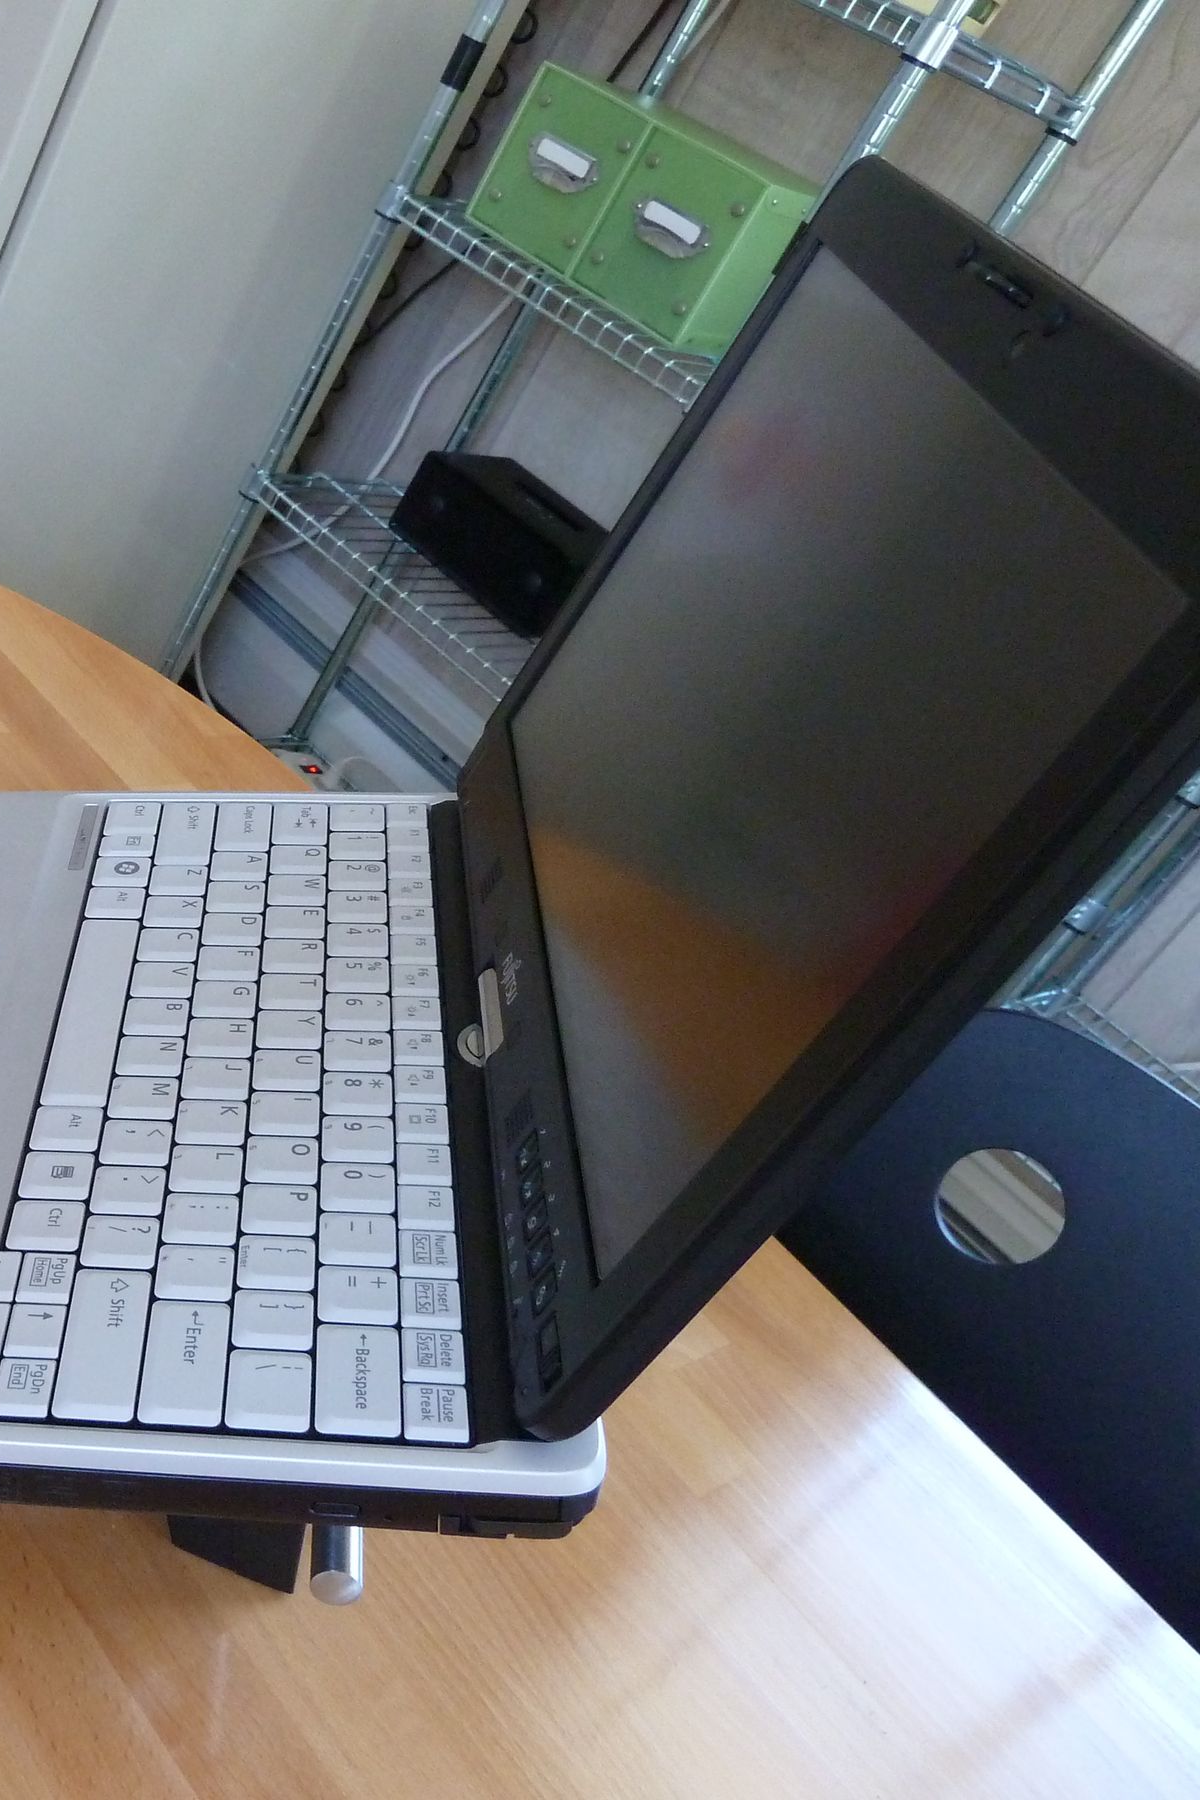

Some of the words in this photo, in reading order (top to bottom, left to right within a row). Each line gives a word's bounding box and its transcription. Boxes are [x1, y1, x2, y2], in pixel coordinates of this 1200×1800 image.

[301, 807, 311, 818] Tab
[188, 815, 199, 829] Shift
[244, 820, 254, 834] Lock
[305, 848, 320, 857] Q
[246, 855, 262, 864] A
[411, 855, 421, 863] F2
[364, 864, 381, 873] @
[304, 878, 320, 889] W
[182, 900, 198, 908] X
[241, 917, 257, 925] D
[177, 932, 193, 940] C
[346, 927, 362, 935] 4
[416, 937, 427, 946] F5
[367, 961, 383, 971] %
[172, 967, 189, 976] V
[418, 968, 429, 977] F6
[299, 979, 317, 987] T
[501, 952, 521, 1005] FUJITSU
[233, 986, 250, 996] G
[166, 1003, 183, 1011] B
[345, 998, 363, 1006] 6
[419, 1000, 430, 1009] F7
[297, 1016, 316, 1026] Y
[229, 1023, 247, 1033] H
[346, 1037, 363, 1045] 7
[368, 1038, 383, 1047] &
[421, 1033, 432, 1043] F8
[159, 1042, 178, 1051] N
[295, 1055, 314, 1065] U
[423, 1069, 434, 1080] F9
[344, 1078, 362, 1087] 8
[151, 1083, 171, 1096] M
[220, 1106, 239, 1116] K
[425, 1108, 437, 1124] F10
[68, 1114, 82, 1128] Alt
[344, 1122, 362, 1131] 9
[291, 1144, 311, 1156] O
[427, 1148, 439, 1163] F11
[344, 1170, 363, 1179] 0
[290, 1192, 309, 1201] P
[428, 1190, 441, 1208] F12
[47, 1208, 63, 1227] Ctrl
[33, 1260, 48, 1283] Home
[50, 1258, 68, 1285] PgUp
[438, 1283, 449, 1312] Insert
[107, 1299, 125, 1328] Shift
[183, 1327, 201, 1365] Enter
[440, 1334, 453, 1367] Delete
[11, 1366, 26, 1386] End
[30, 1364, 48, 1394] PgDn
[352, 1348, 371, 1410] Backspace
[420, 1388, 434, 1422] Break
[442, 1389, 456, 1423] Pause
